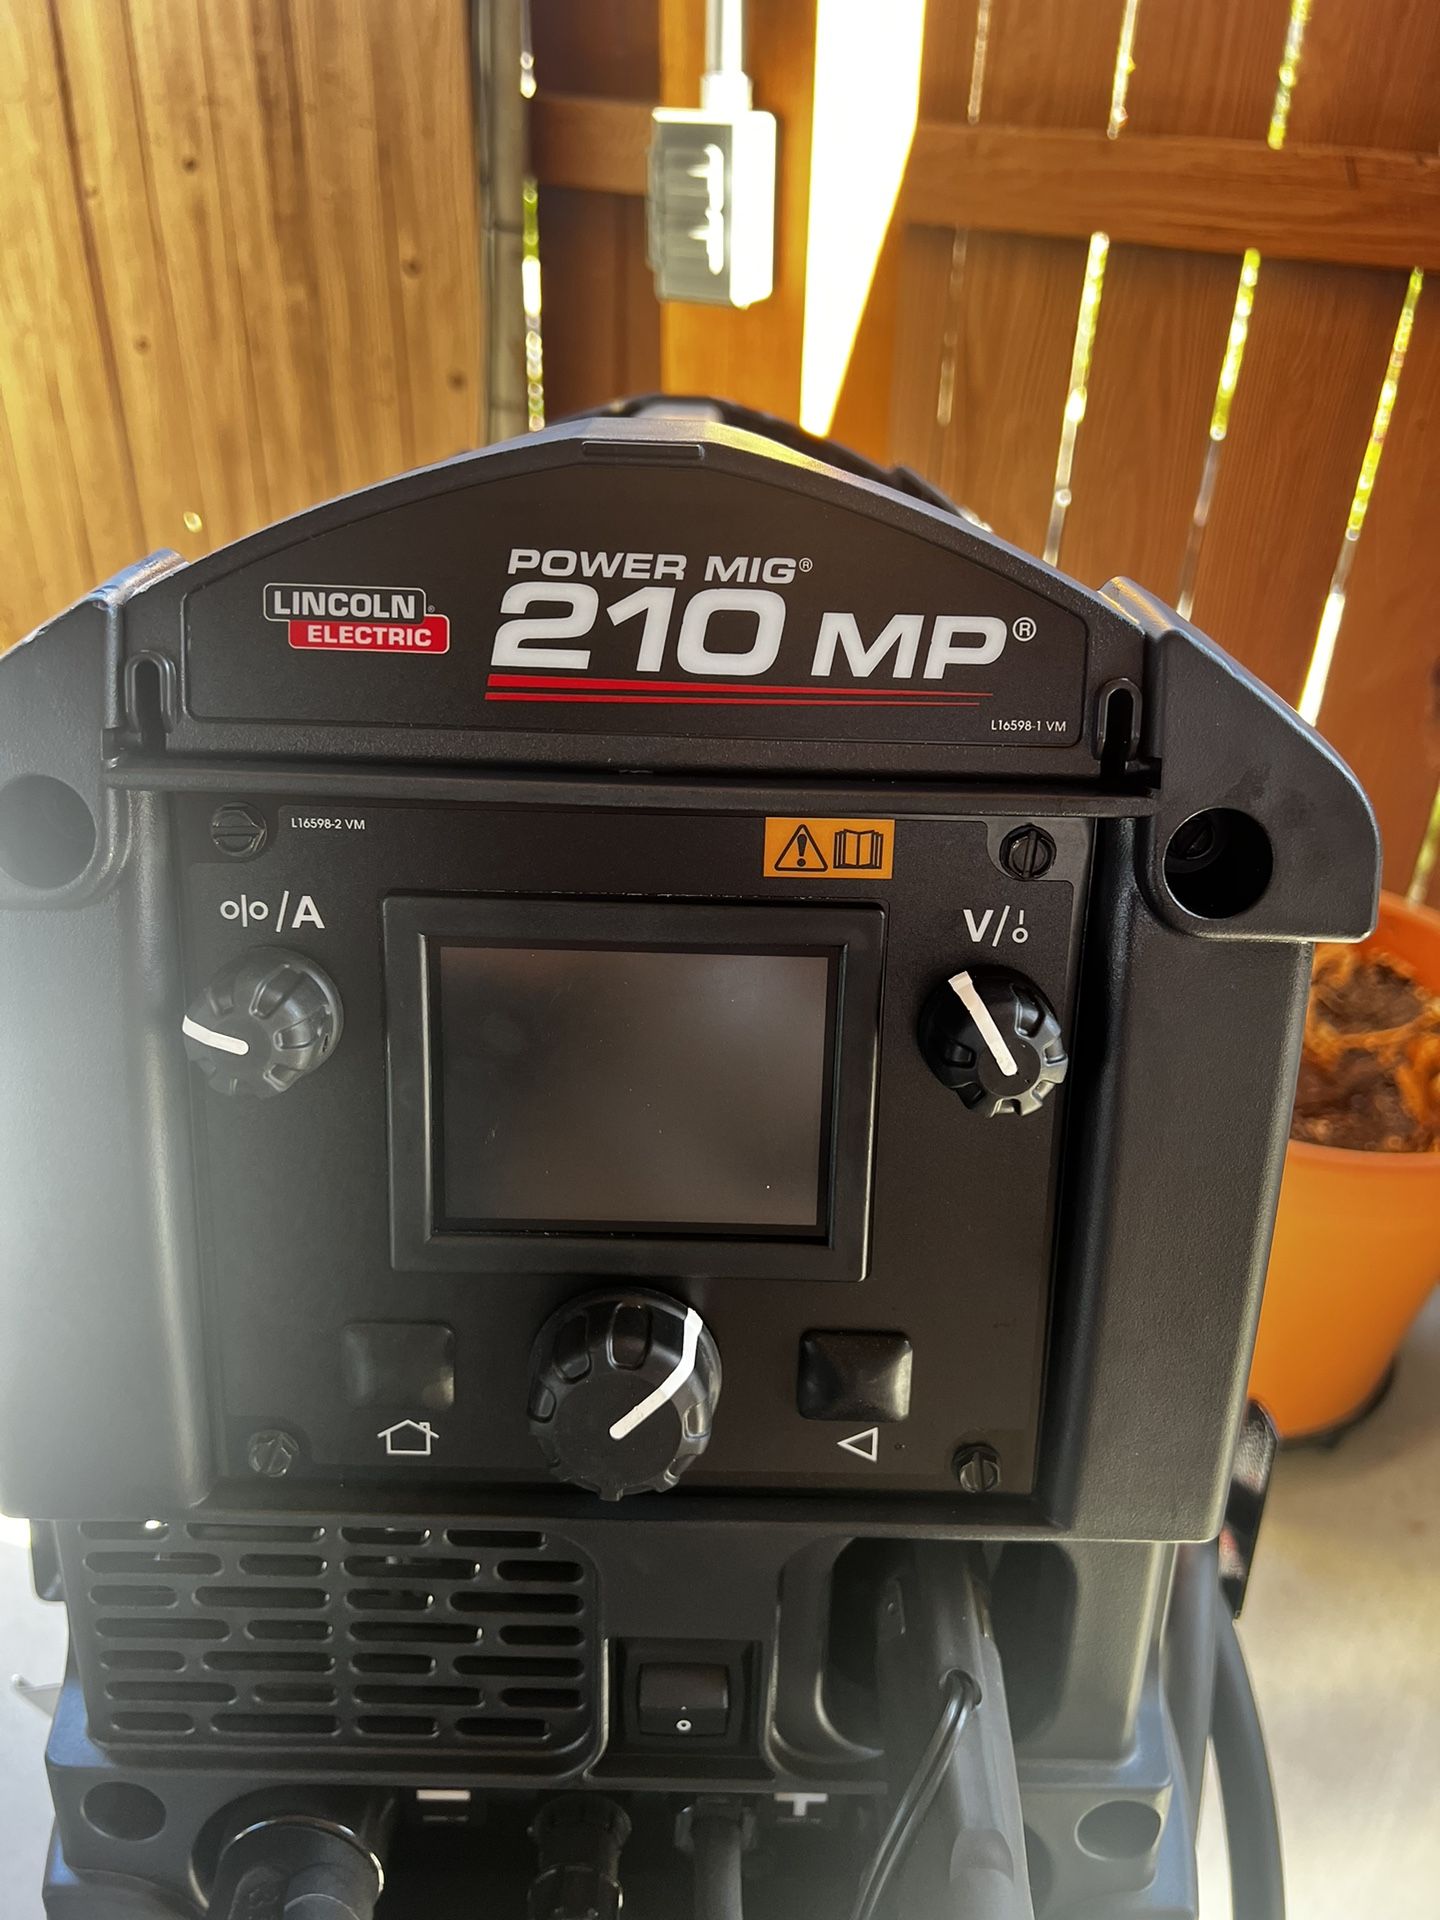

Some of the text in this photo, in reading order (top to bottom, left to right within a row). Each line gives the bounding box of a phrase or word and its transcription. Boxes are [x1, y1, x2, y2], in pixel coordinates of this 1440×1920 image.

[507, 548, 688, 580] POWER
[273, 590, 416, 620] LINCOLN
[307, 624, 432, 647] ELECTRIC
[490, 581, 787, 677] 210
[991, 719, 1067, 732] L16598-1 VM
[291, 817, 366, 830] L16598-2 VM
